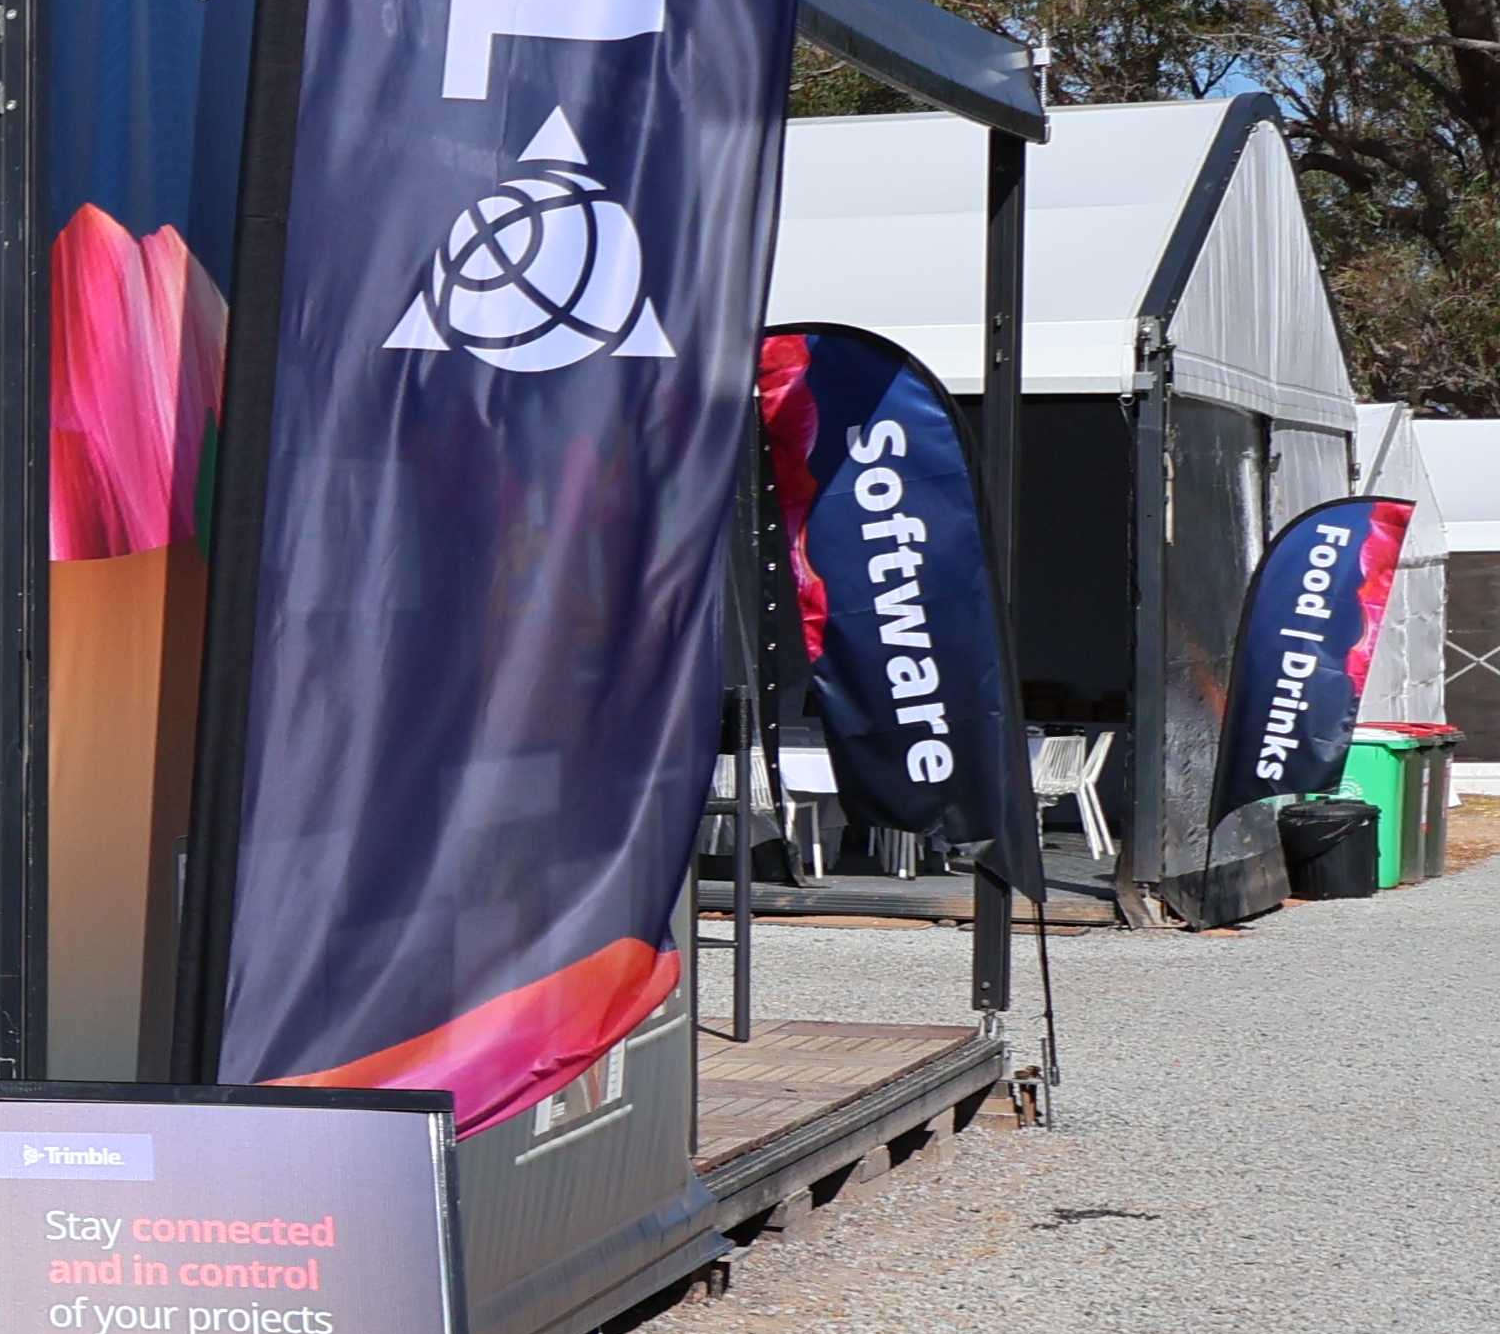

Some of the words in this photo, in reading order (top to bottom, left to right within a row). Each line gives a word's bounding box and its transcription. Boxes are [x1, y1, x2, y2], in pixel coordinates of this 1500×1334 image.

[846, 419, 954, 784] Software
[1294, 524, 1352, 620] Food
[1256, 650, 1318, 782] Drinks
[45, 1209, 123, 1250] Stay
[131, 1215, 336, 1248] connected
[47, 1253, 123, 1286] and
[132, 1253, 170, 1287] in
[178, 1258, 320, 1291] control
[49, 1296, 89, 1329] of
